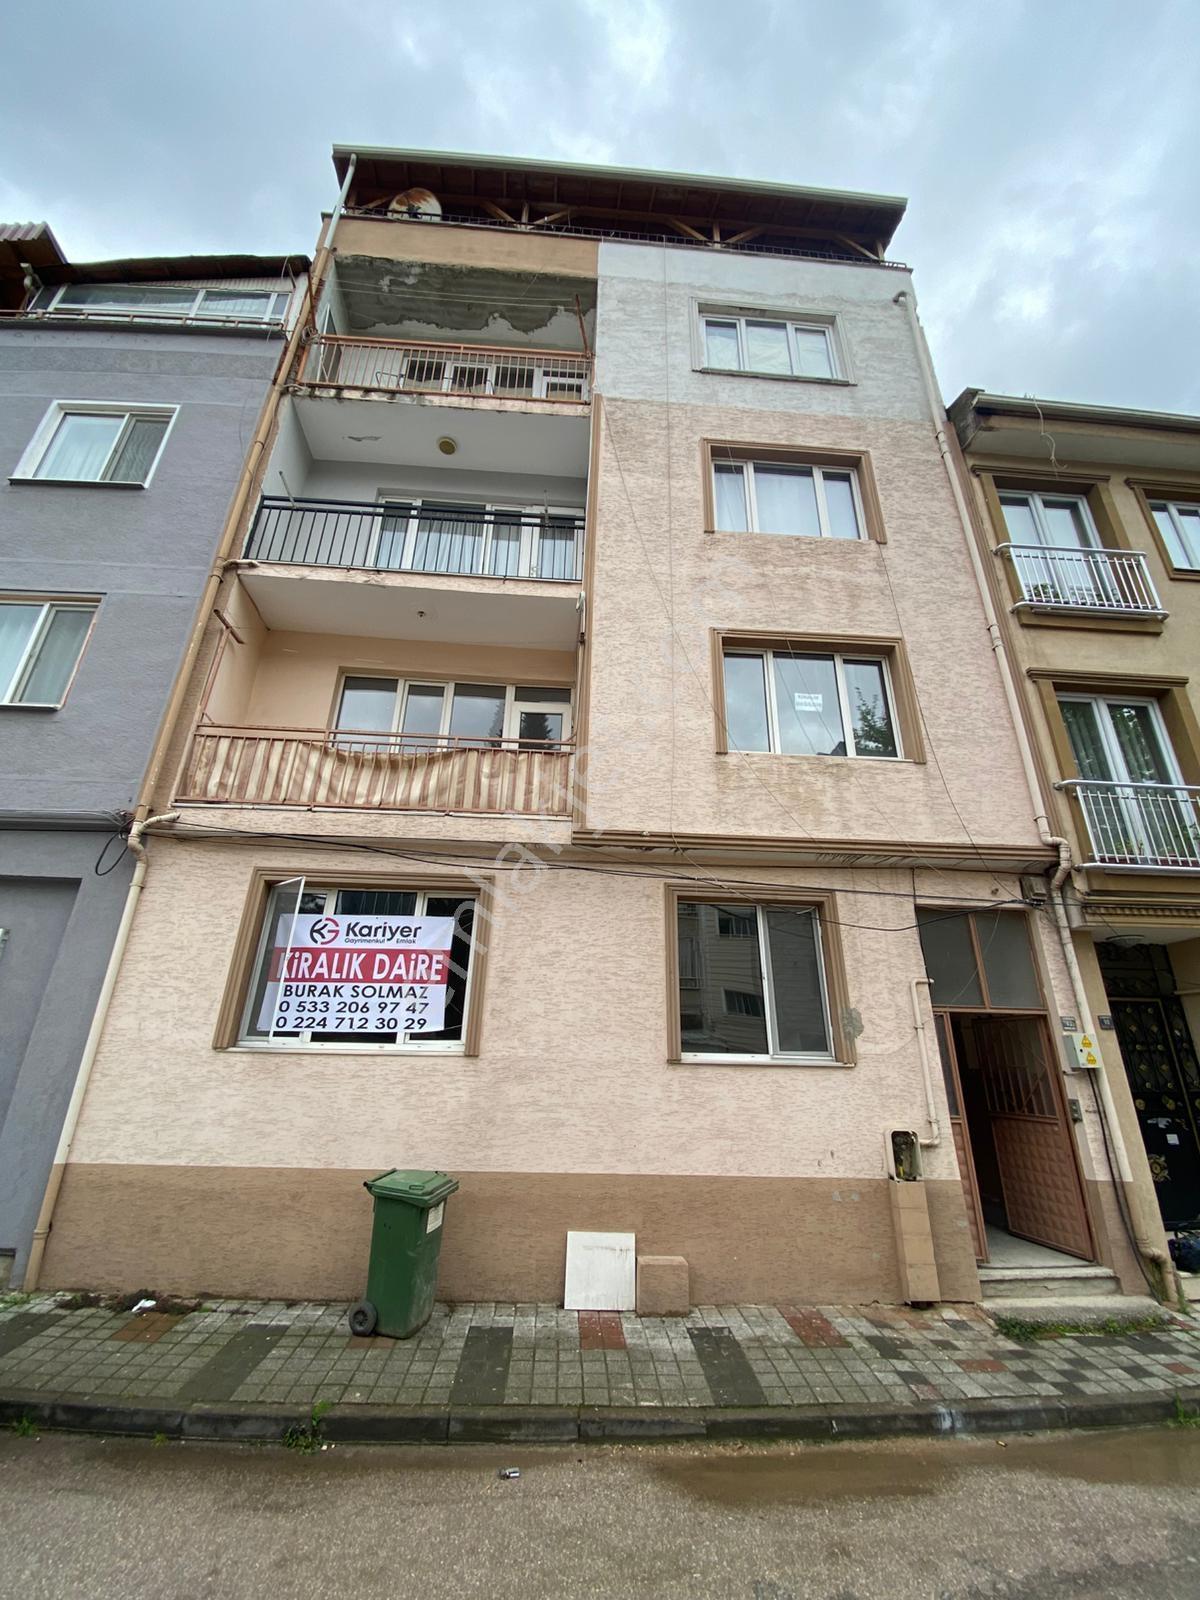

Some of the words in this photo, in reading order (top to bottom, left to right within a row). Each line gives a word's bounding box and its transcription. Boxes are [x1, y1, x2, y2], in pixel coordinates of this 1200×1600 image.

[345, 922, 422, 941] Kariyer
[283, 984, 345, 998] BURAK
[350, 984, 428, 999] SOLMAZ
[279, 1001, 290, 1013] 0
[295, 1001, 330, 1013] 533
[335, 1001, 370, 1014] 206
[378, 1001, 401, 1014] 97
[406, 1002, 429, 1015] 47
[275, 1016, 288, 1029] 0
[292, 1016, 328, 1029] 224
[335, 1017, 369, 1030] 712
[375, 1017, 399, 1030] 30
[404, 1017, 428, 1030] 29
